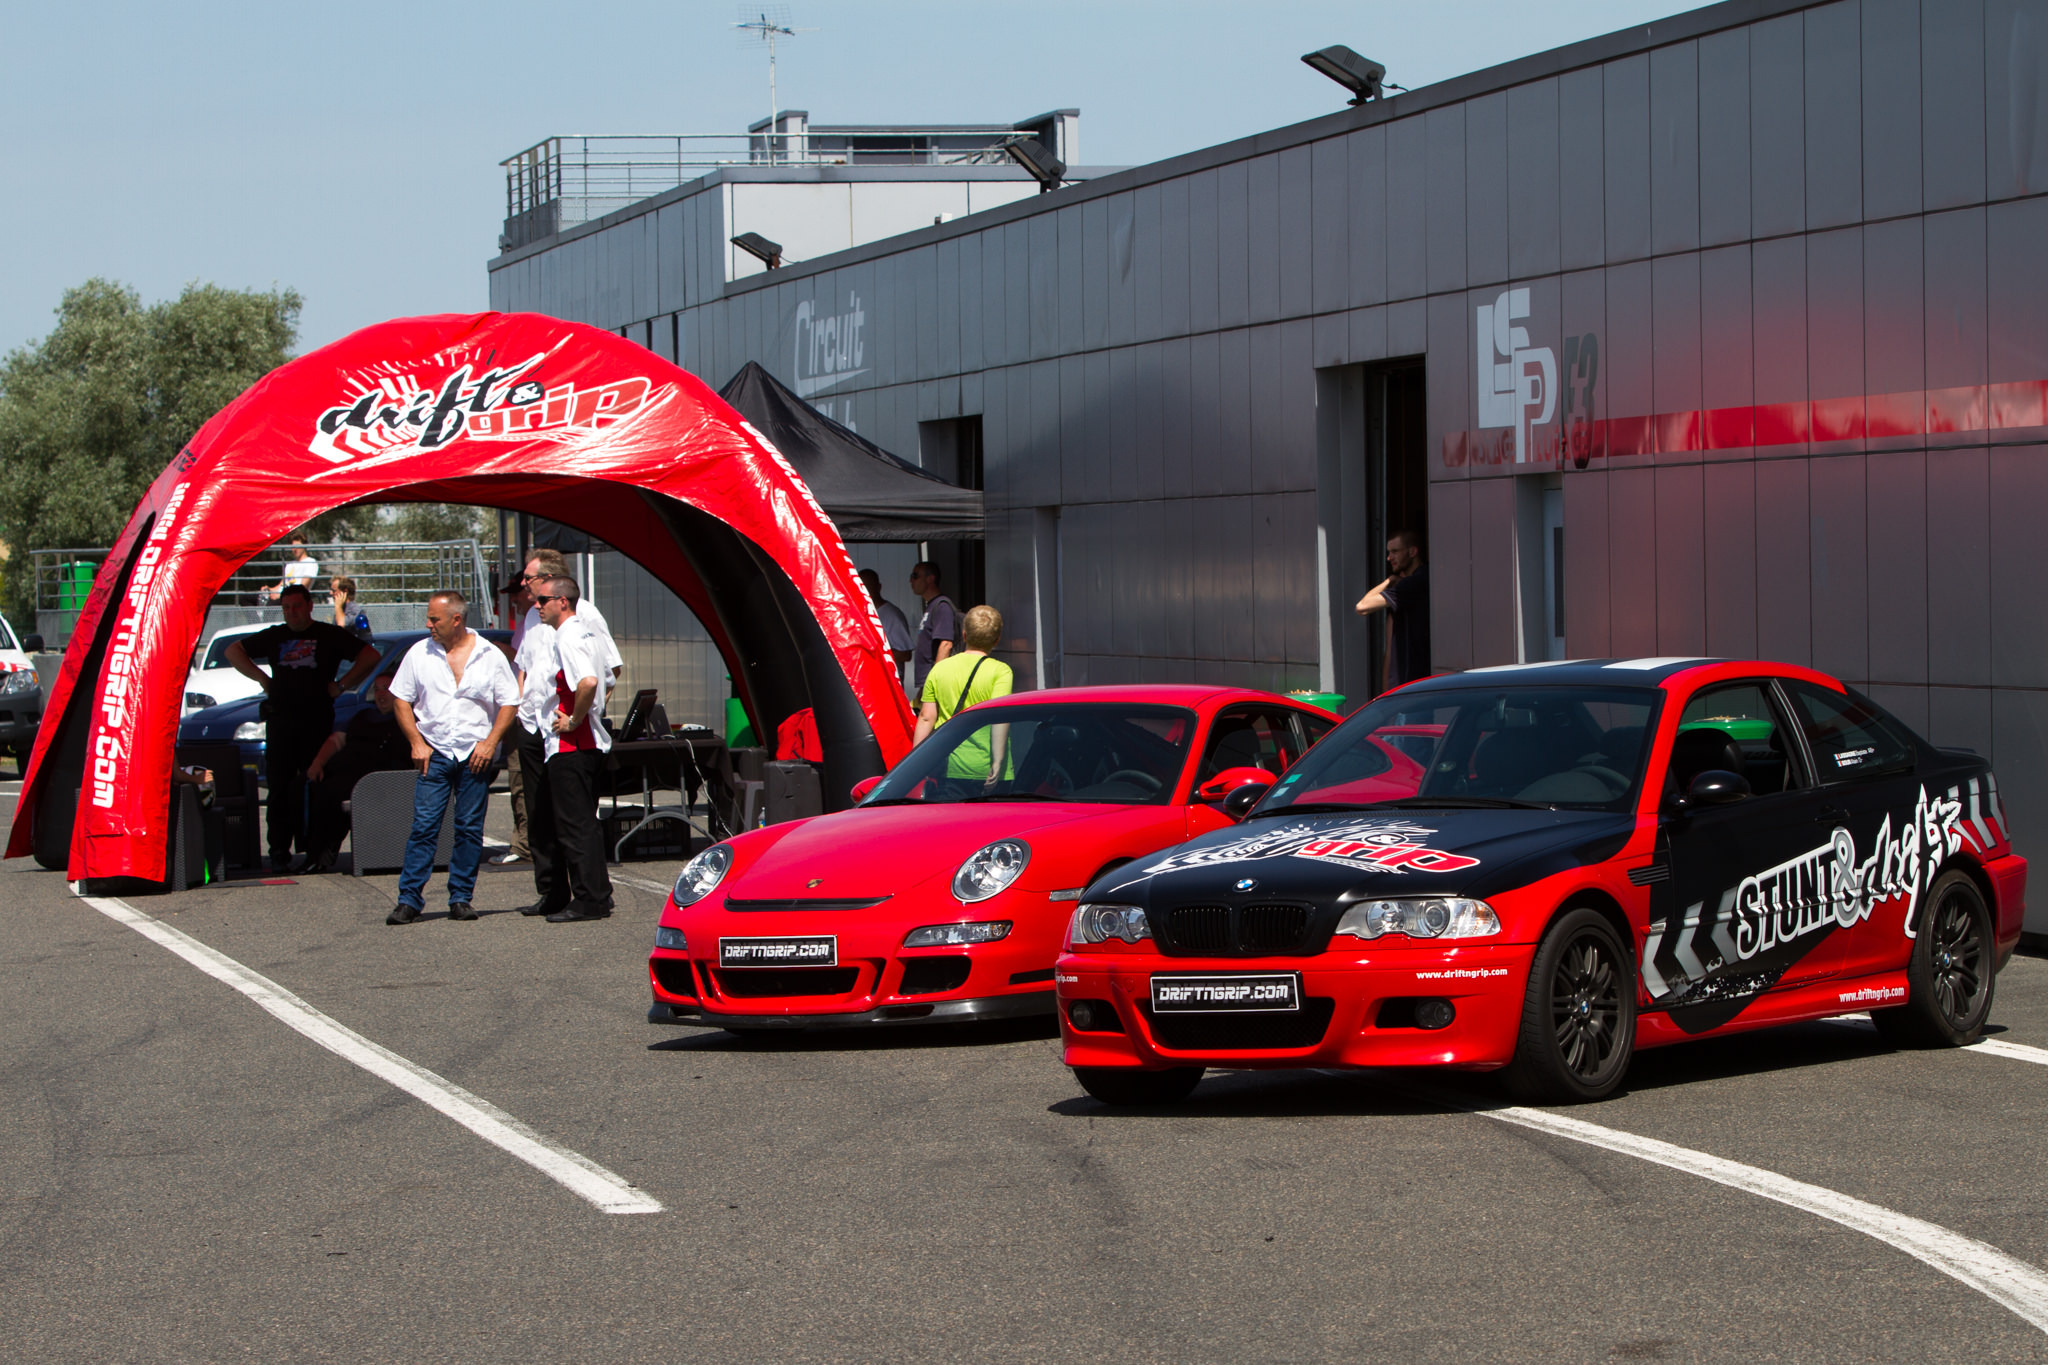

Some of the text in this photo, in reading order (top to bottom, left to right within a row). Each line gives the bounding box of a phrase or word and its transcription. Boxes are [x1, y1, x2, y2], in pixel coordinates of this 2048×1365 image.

[794, 290, 870, 398] Circuit
[1416, 968, 1507, 979] www.driftngrip.com
[1838, 986, 1904, 1002] www.driftngrip.com
